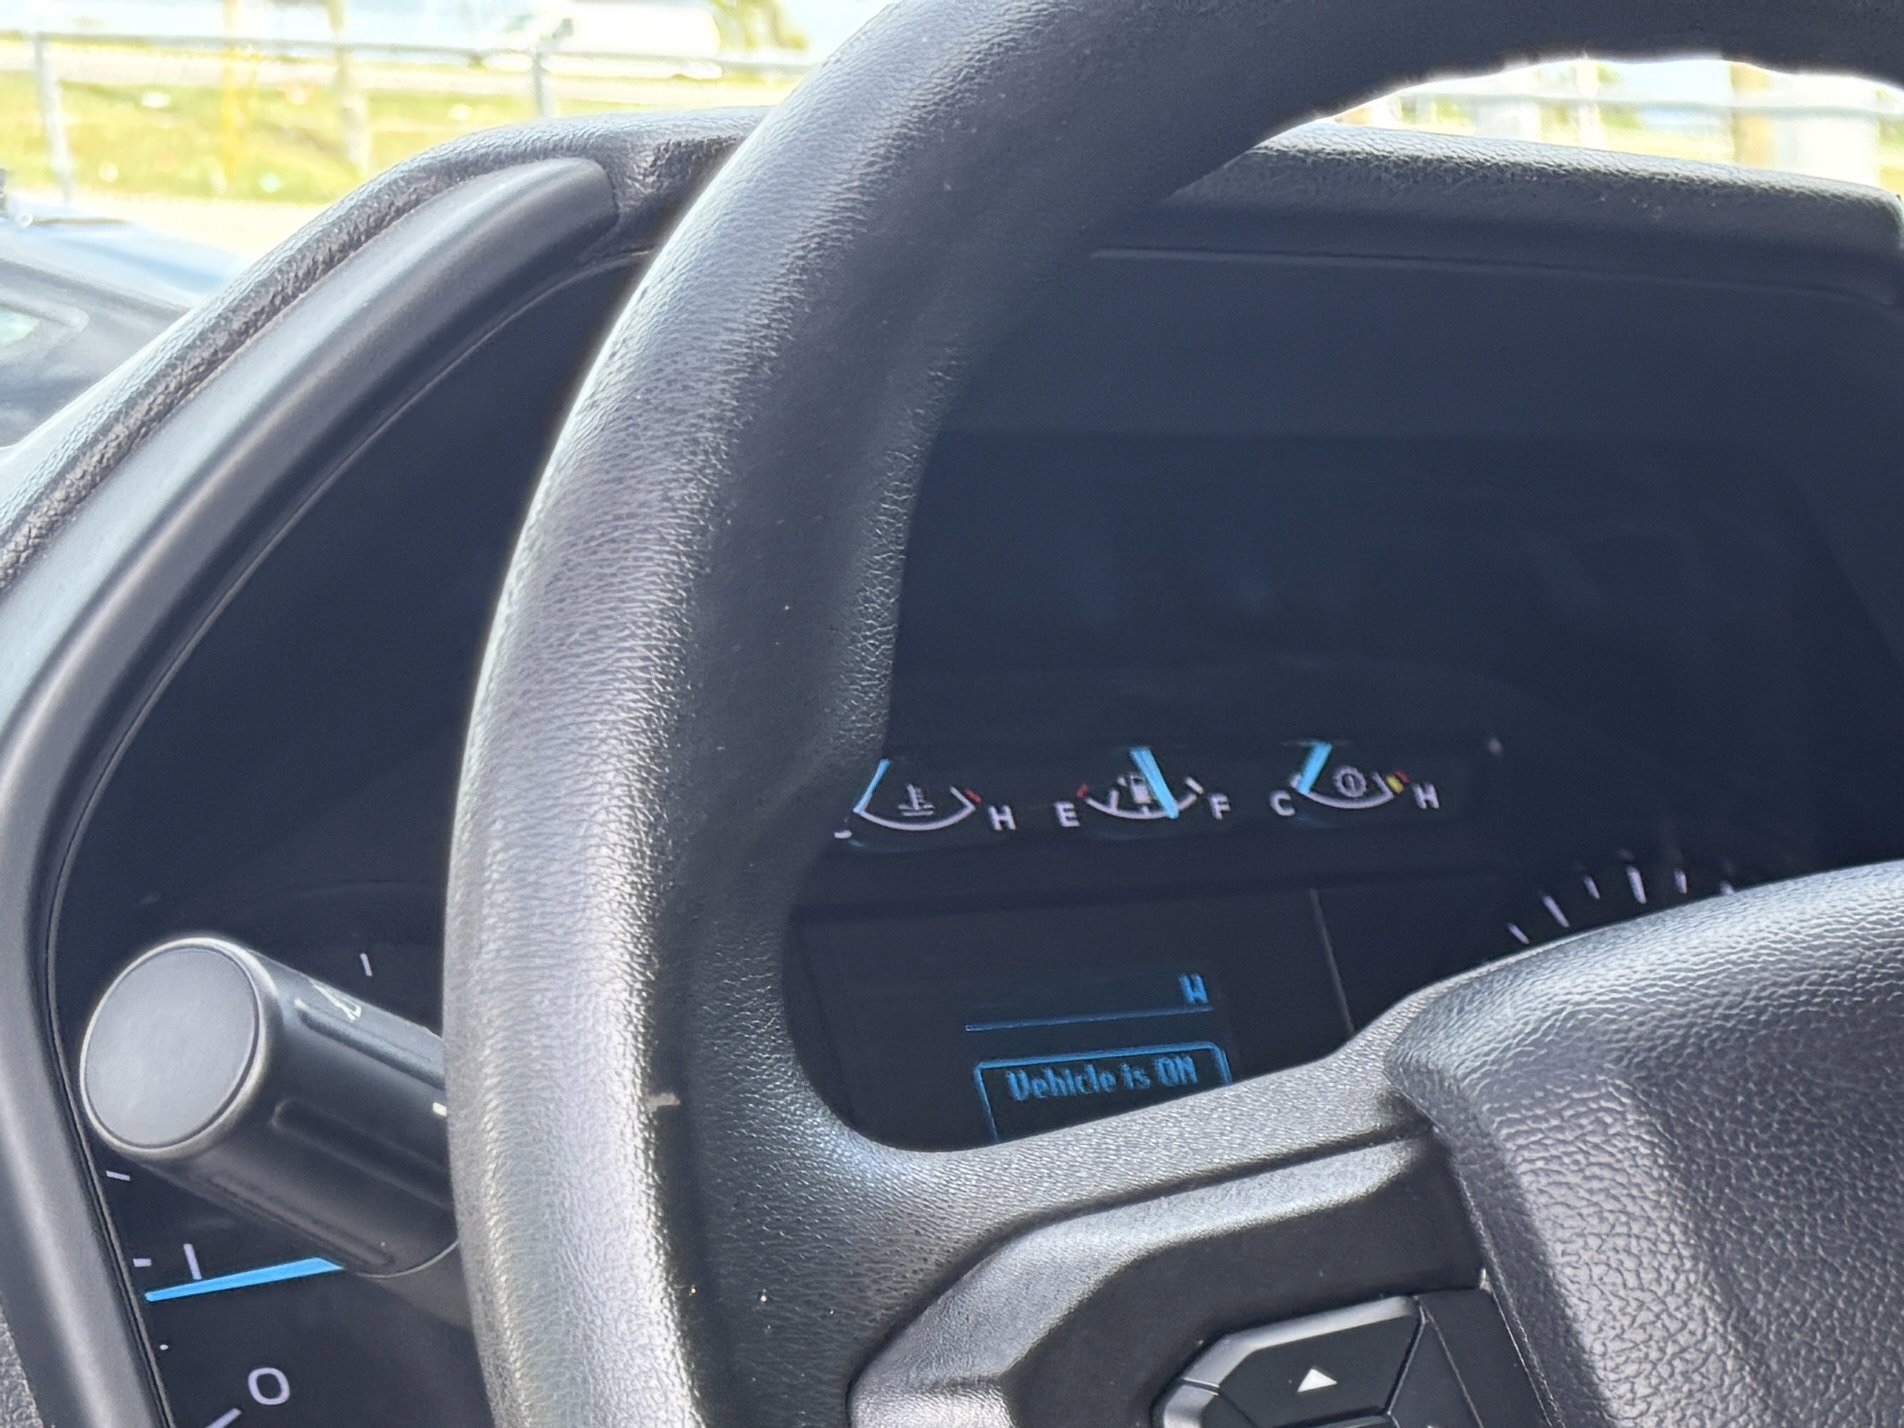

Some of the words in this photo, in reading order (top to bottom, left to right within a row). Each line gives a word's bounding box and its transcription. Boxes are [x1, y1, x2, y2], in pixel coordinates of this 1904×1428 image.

[987, 805, 1017, 831] H
[1055, 802, 1081, 829] E
[1209, 793, 1231, 819] F
[1006, 1064, 1117, 1101] Vehicle
[1120, 1062, 1151, 1089] is
[1155, 1055, 1198, 1087] ON
[248, 1367, 290, 1405] 0
